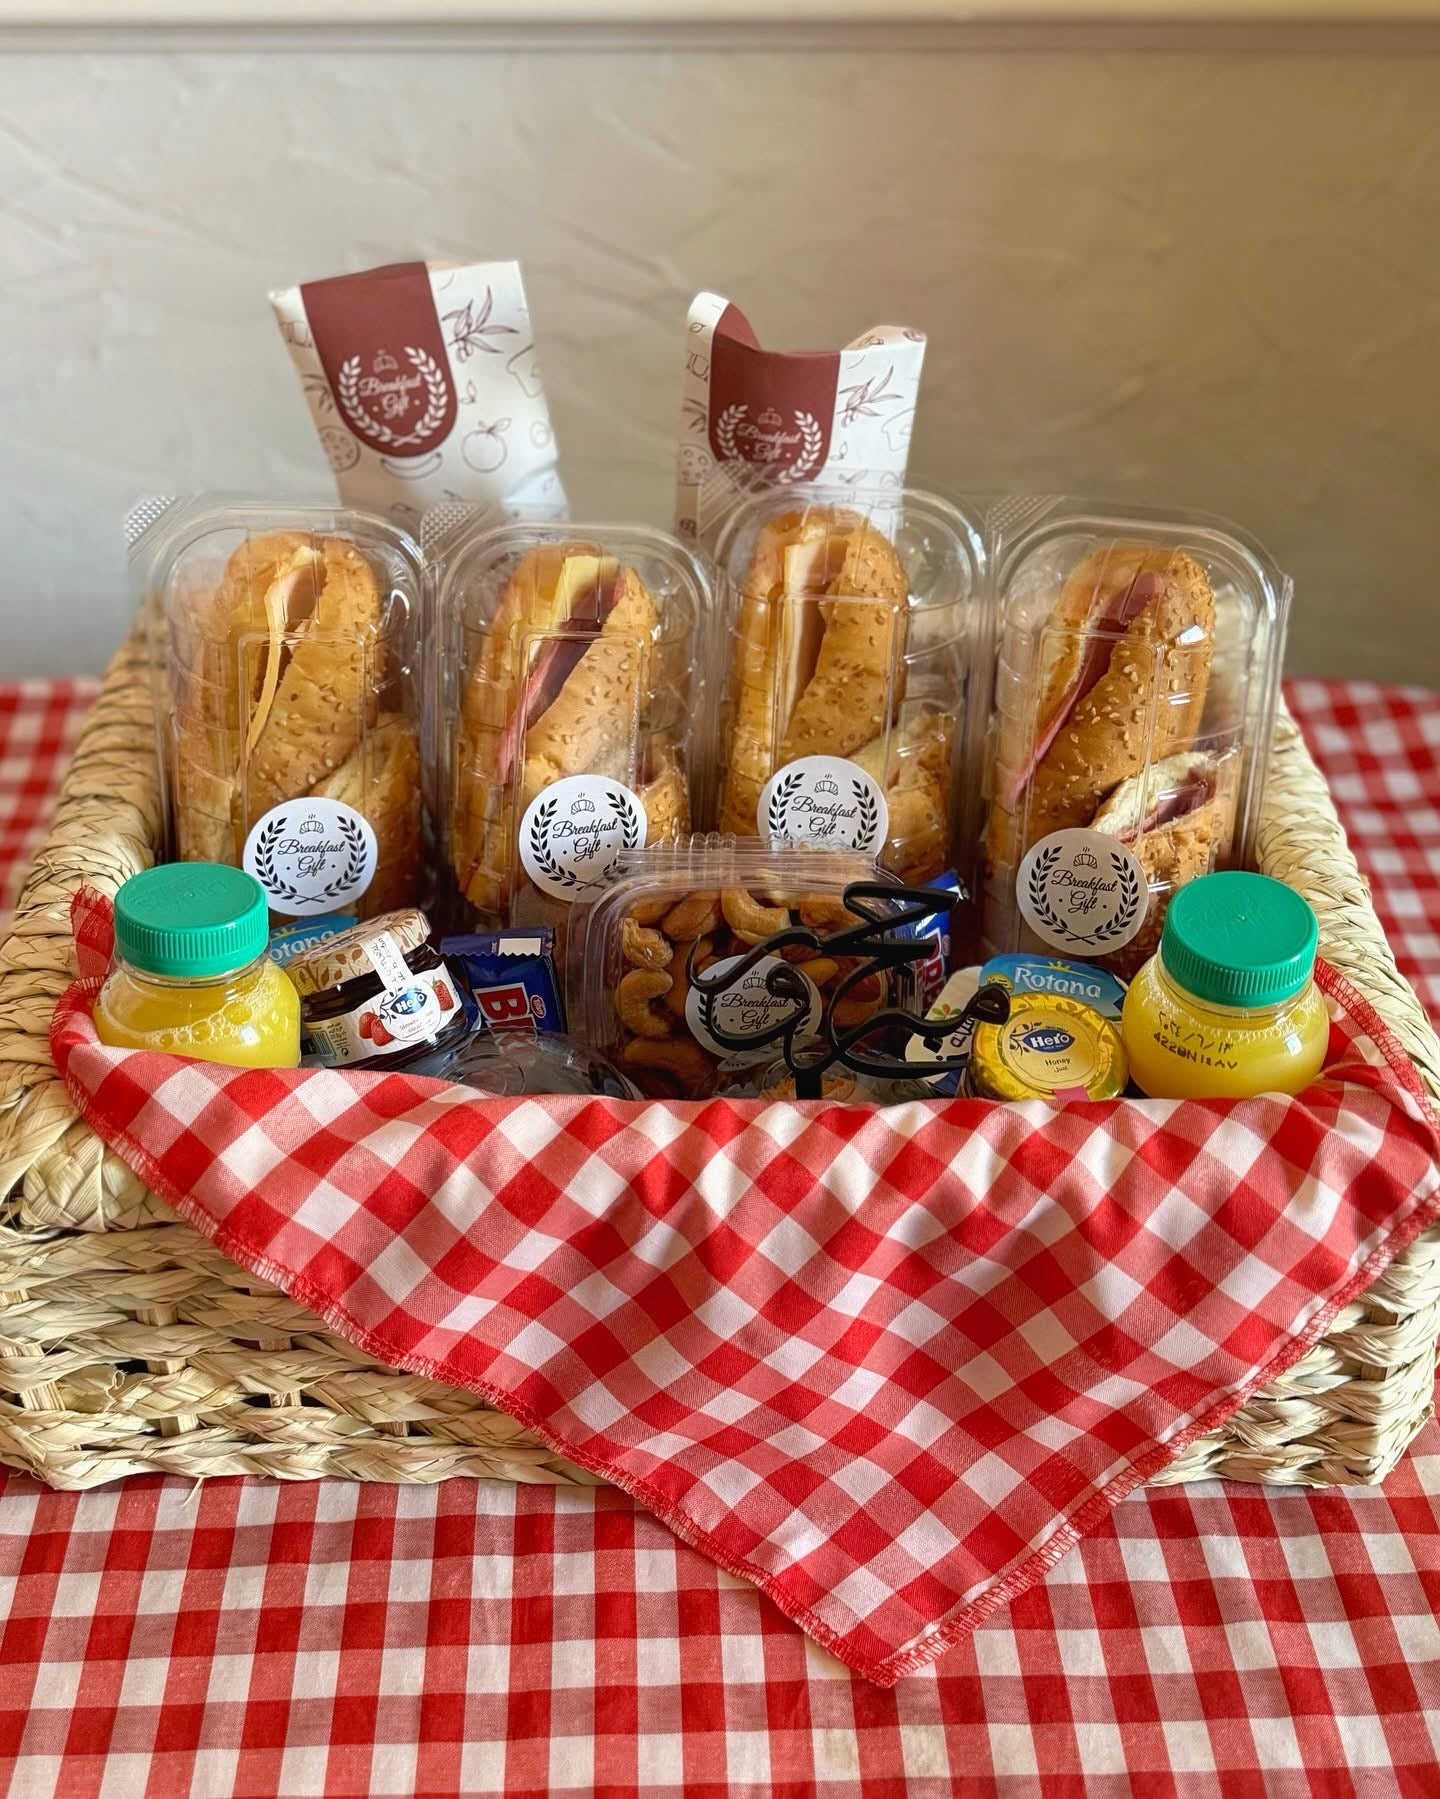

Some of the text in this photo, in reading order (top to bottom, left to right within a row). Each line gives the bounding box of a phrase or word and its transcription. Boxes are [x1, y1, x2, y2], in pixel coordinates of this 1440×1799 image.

[791, 795, 858, 821] Breakfast
[552, 817, 617, 839] Breakfast
[808, 816, 836, 838] Gift
[277, 838, 346, 858] Breakfast
[573, 837, 601, 862] Gift
[296, 855, 326, 878] Gift
[1051, 869, 1118, 895] Breakfast
[1067, 890, 1098, 914] Gift
[1014, 966, 1101, 998] Rotana
[395, 993, 425, 1013] Heo
[720, 993, 789, 1013] Breakfast
[740, 1009, 770, 1030] Gift
[1030, 1032, 1070, 1048] Hero
[1044, 1057, 1071, 1067] Honey
